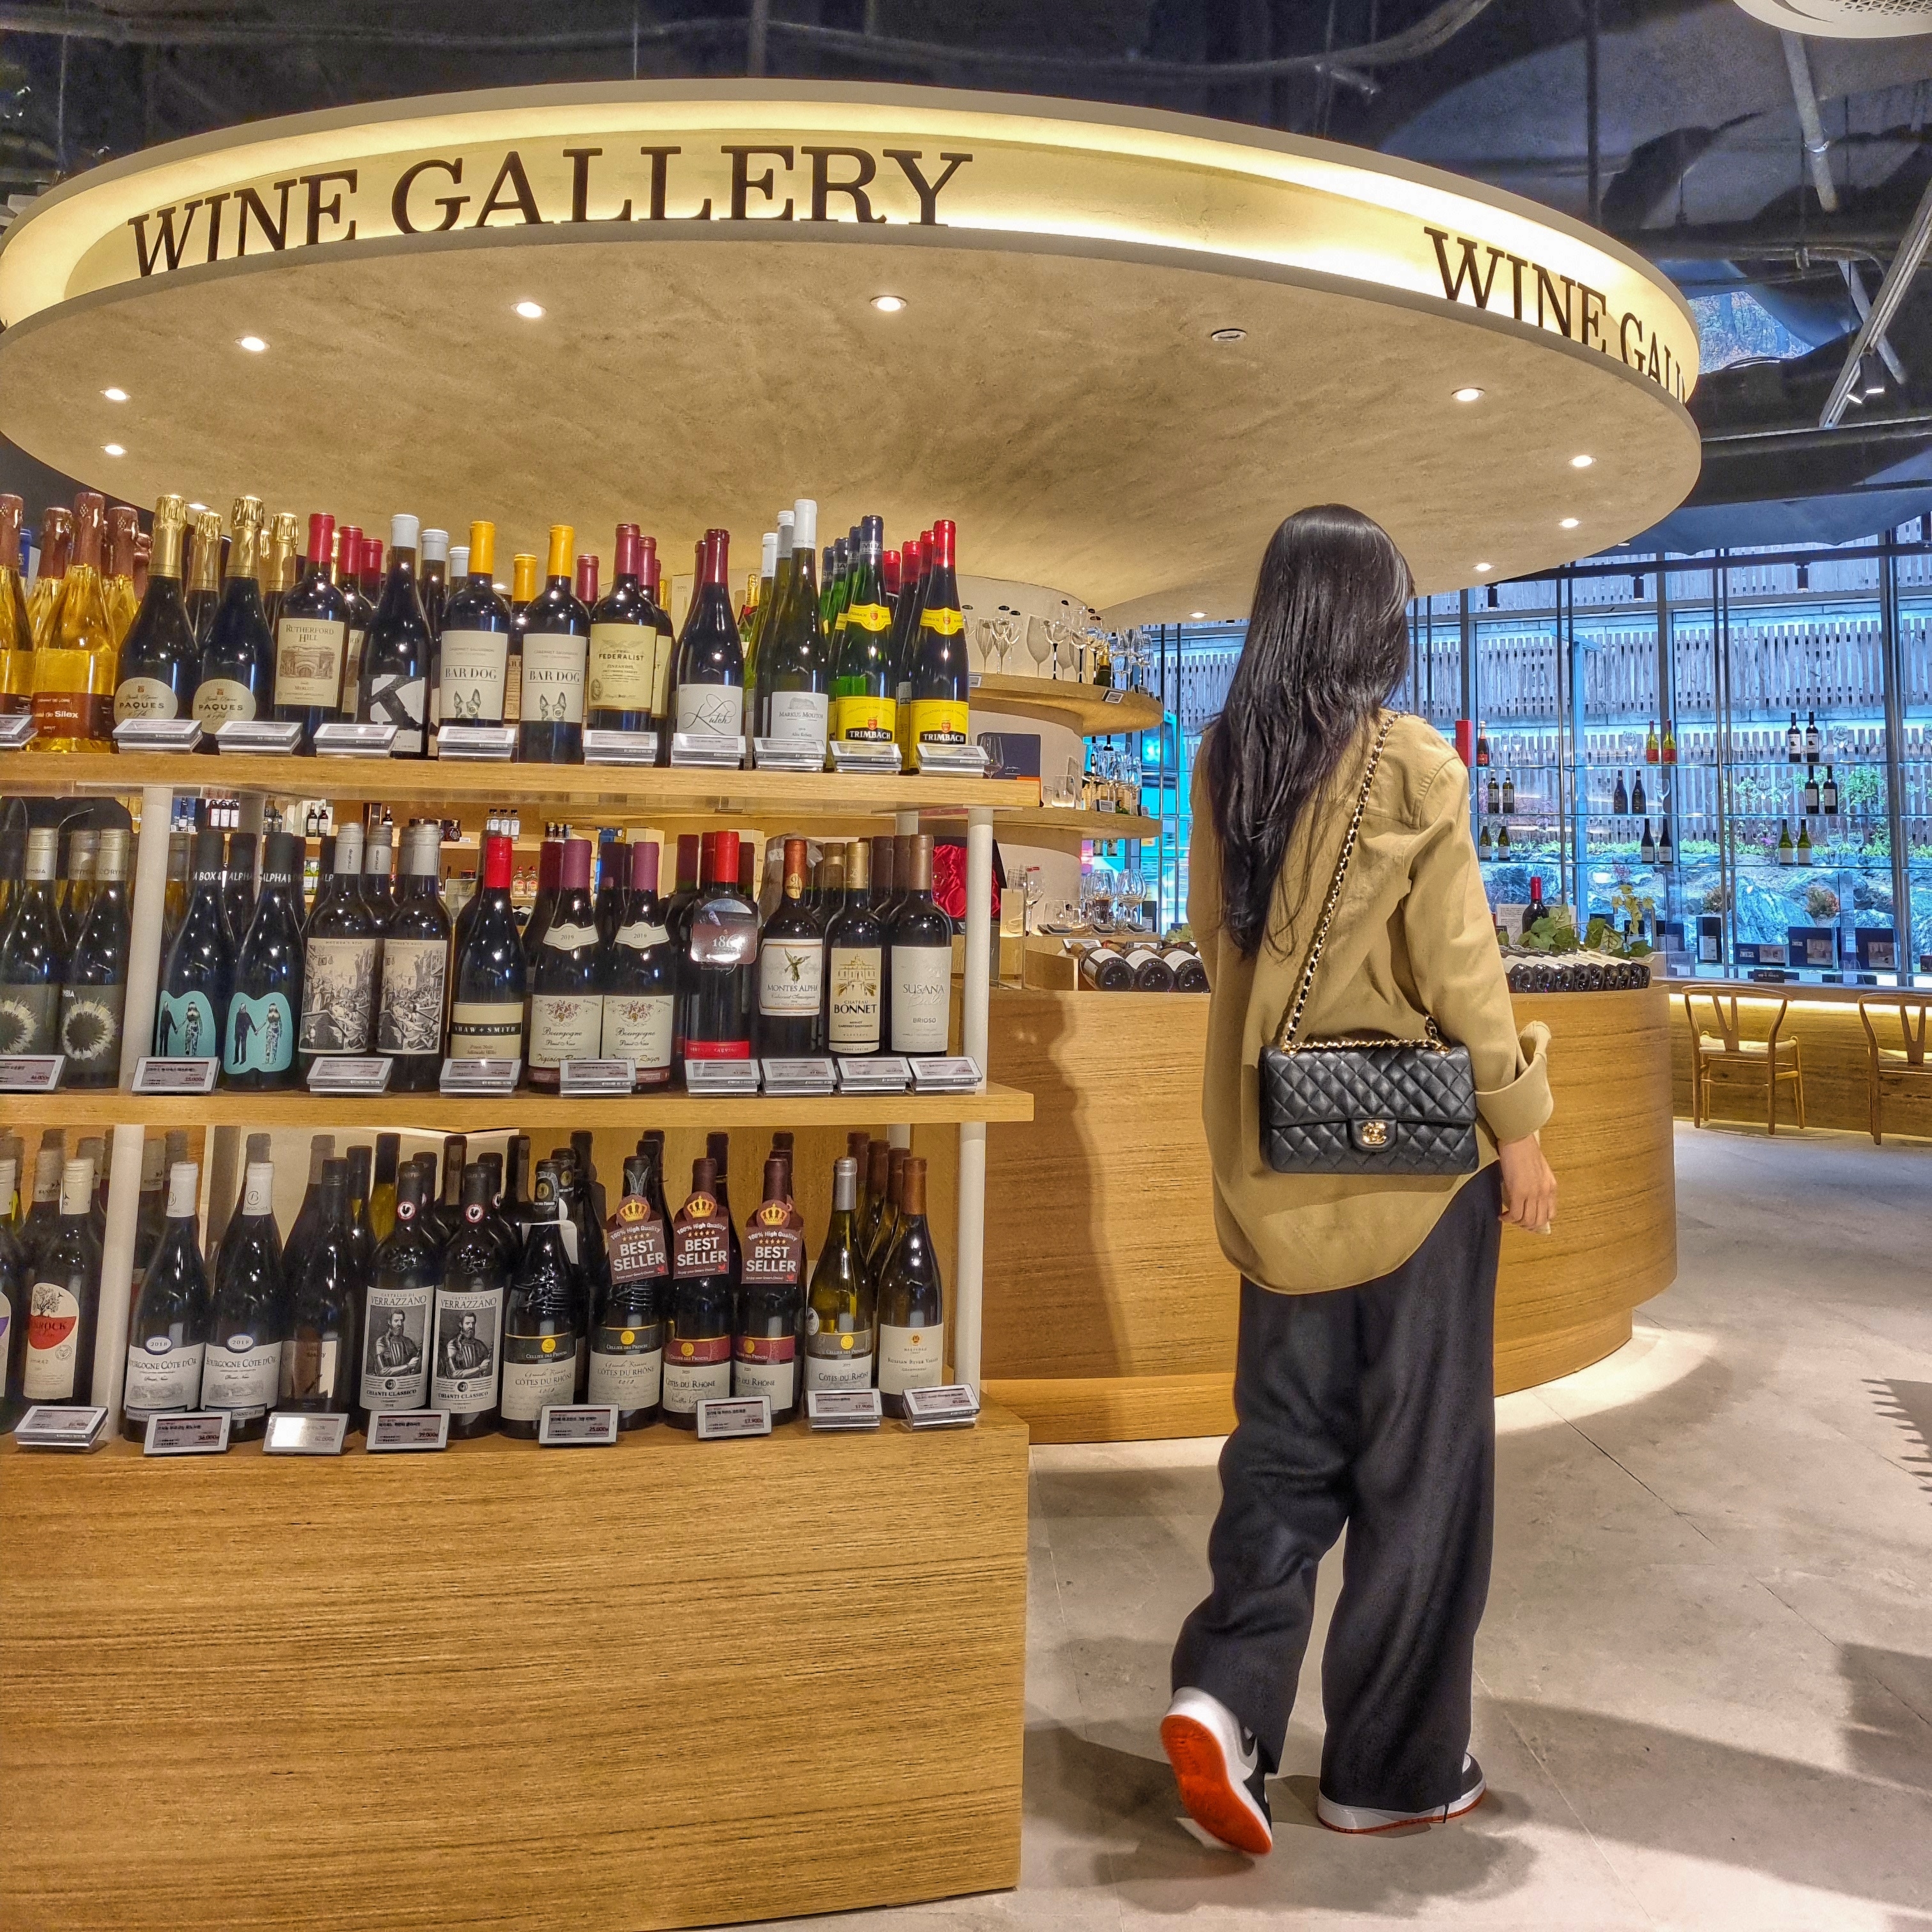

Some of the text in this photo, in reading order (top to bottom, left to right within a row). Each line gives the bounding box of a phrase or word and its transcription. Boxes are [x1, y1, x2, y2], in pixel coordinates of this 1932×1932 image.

[128, 145, 974, 278] WINE GALLERY
[1424, 226, 1606, 354] WINE
[286, 624, 334, 635] RUTHERFORD
[299, 634, 319, 642] HILL
[445, 668, 497, 680] BAR DOG
[530, 670, 580, 682] BAR DOG
[54, 710, 79, 719] Silex
[850, 730, 891, 740] TRIMBACH
[924, 733, 964, 742] TRIMBACH
[199, 872, 216, 881] BOX
[261, 873, 286, 883] ALPHA
[903, 984, 945, 994] SUSANA
[834, 1004, 877, 1014] BONNET
[542, 1026, 583, 1039] Bourgogne
[615, 1027, 656, 1039] Bourgogne
[610, 1229, 626, 1240] 100%
[676, 1225, 693, 1235] 100%
[707, 1223, 726, 1231] Quality
[747, 1232, 763, 1241] 100%
[778, 1231, 798, 1241] Quality
[620, 1239, 656, 1257] BEST
[685, 1236, 720, 1252] BEST
[755, 1246, 790, 1259] BEST
[613, 1252, 665, 1271] SELLER
[677, 1250, 728, 1267] SELLER
[746, 1259, 797, 1273] SELLER
[371, 1295, 427, 1306] VERRAZZANO
[441, 1297, 497, 1308] VERRAZZANO
[206, 1357, 241, 1368] BOURGOGNE
[598, 1367, 618, 1376] CÔTES
[632, 1367, 654, 1376] RHÔNE
[554, 1372, 572, 1383] RHÔNE
[752, 1377, 776, 1386] RHÔNE
[692, 1380, 716, 1388] RHÔNE
[461, 1391, 488, 1399] CLASSICO
